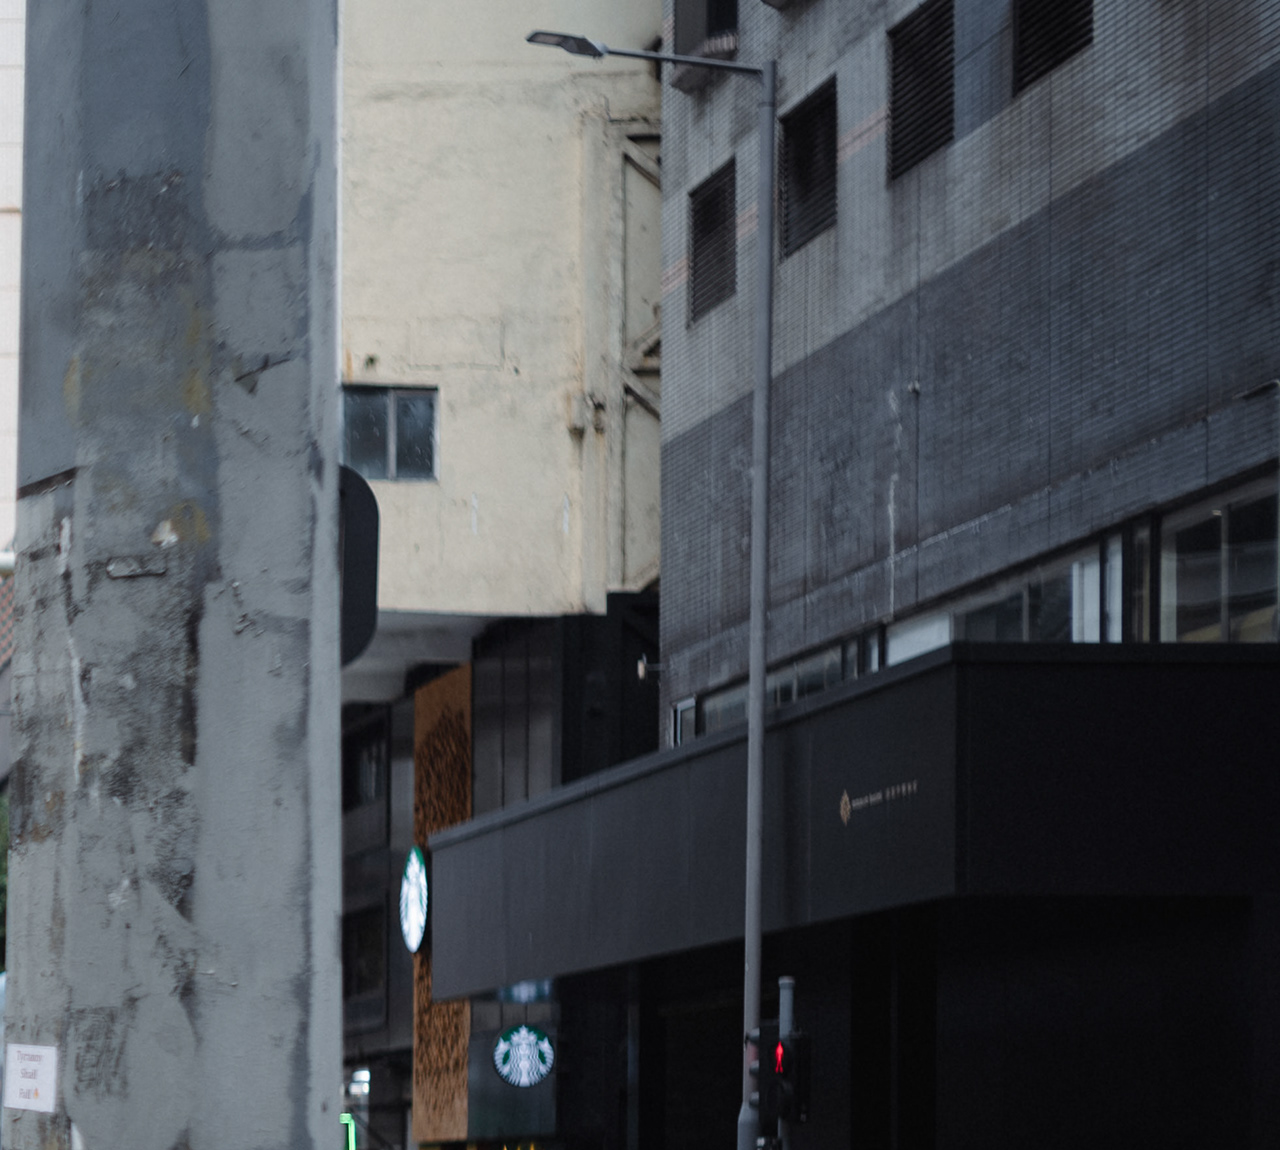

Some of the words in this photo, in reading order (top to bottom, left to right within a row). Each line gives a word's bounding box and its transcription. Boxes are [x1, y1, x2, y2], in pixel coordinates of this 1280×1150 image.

[16, 1050, 44, 1064] Tyranny
[20, 1068, 37, 1080] Shall
[18, 1088, 31, 1100] Fall
